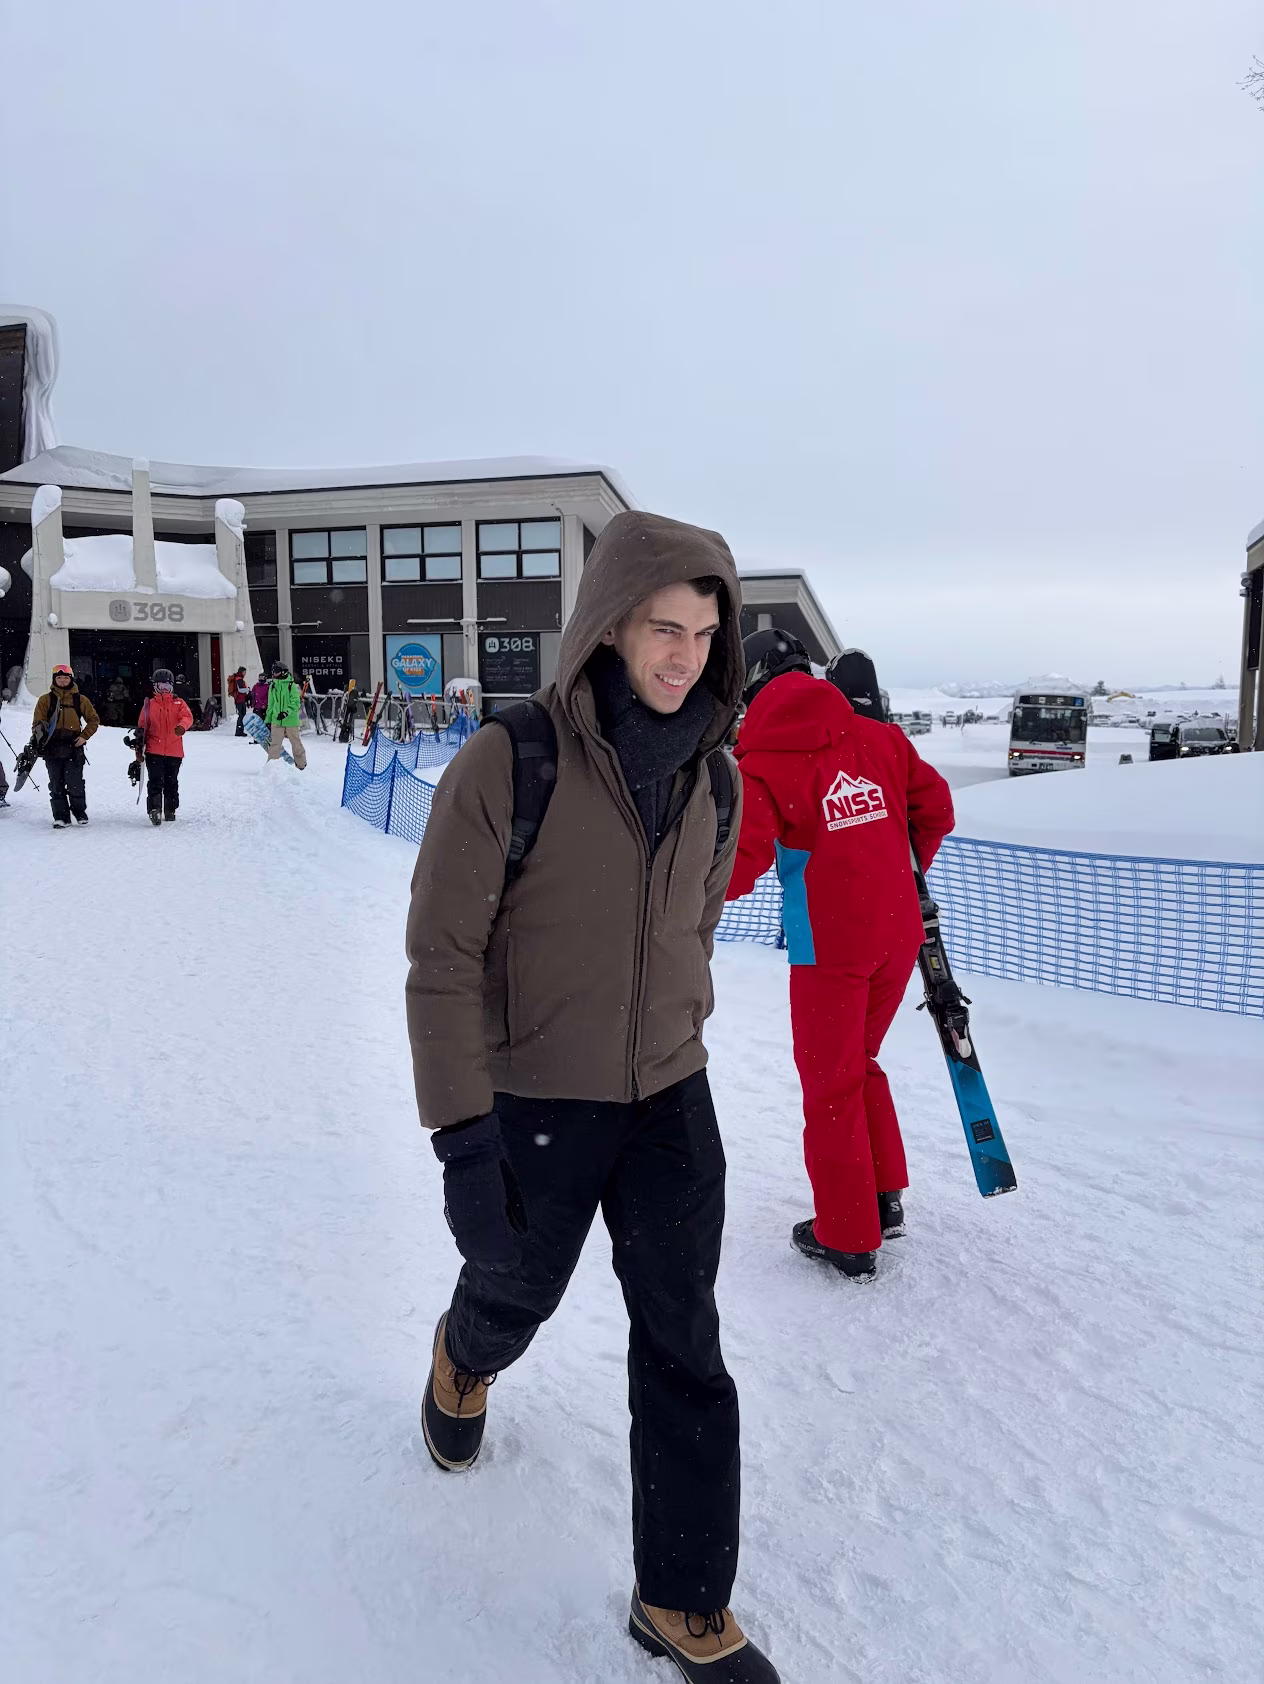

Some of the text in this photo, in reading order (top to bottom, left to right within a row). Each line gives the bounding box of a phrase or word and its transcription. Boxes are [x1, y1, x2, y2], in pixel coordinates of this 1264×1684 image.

[133, 602, 185, 622] 308
[500, 637, 533, 652] 308
[391, 658, 433, 668] GALAXY
[302, 668, 344, 676] SPORTS
[825, 788, 884, 820] NISS
[829, 810, 887, 830] SNOWSPORTS SCHOOL
[890, 1201, 901, 1213] S
